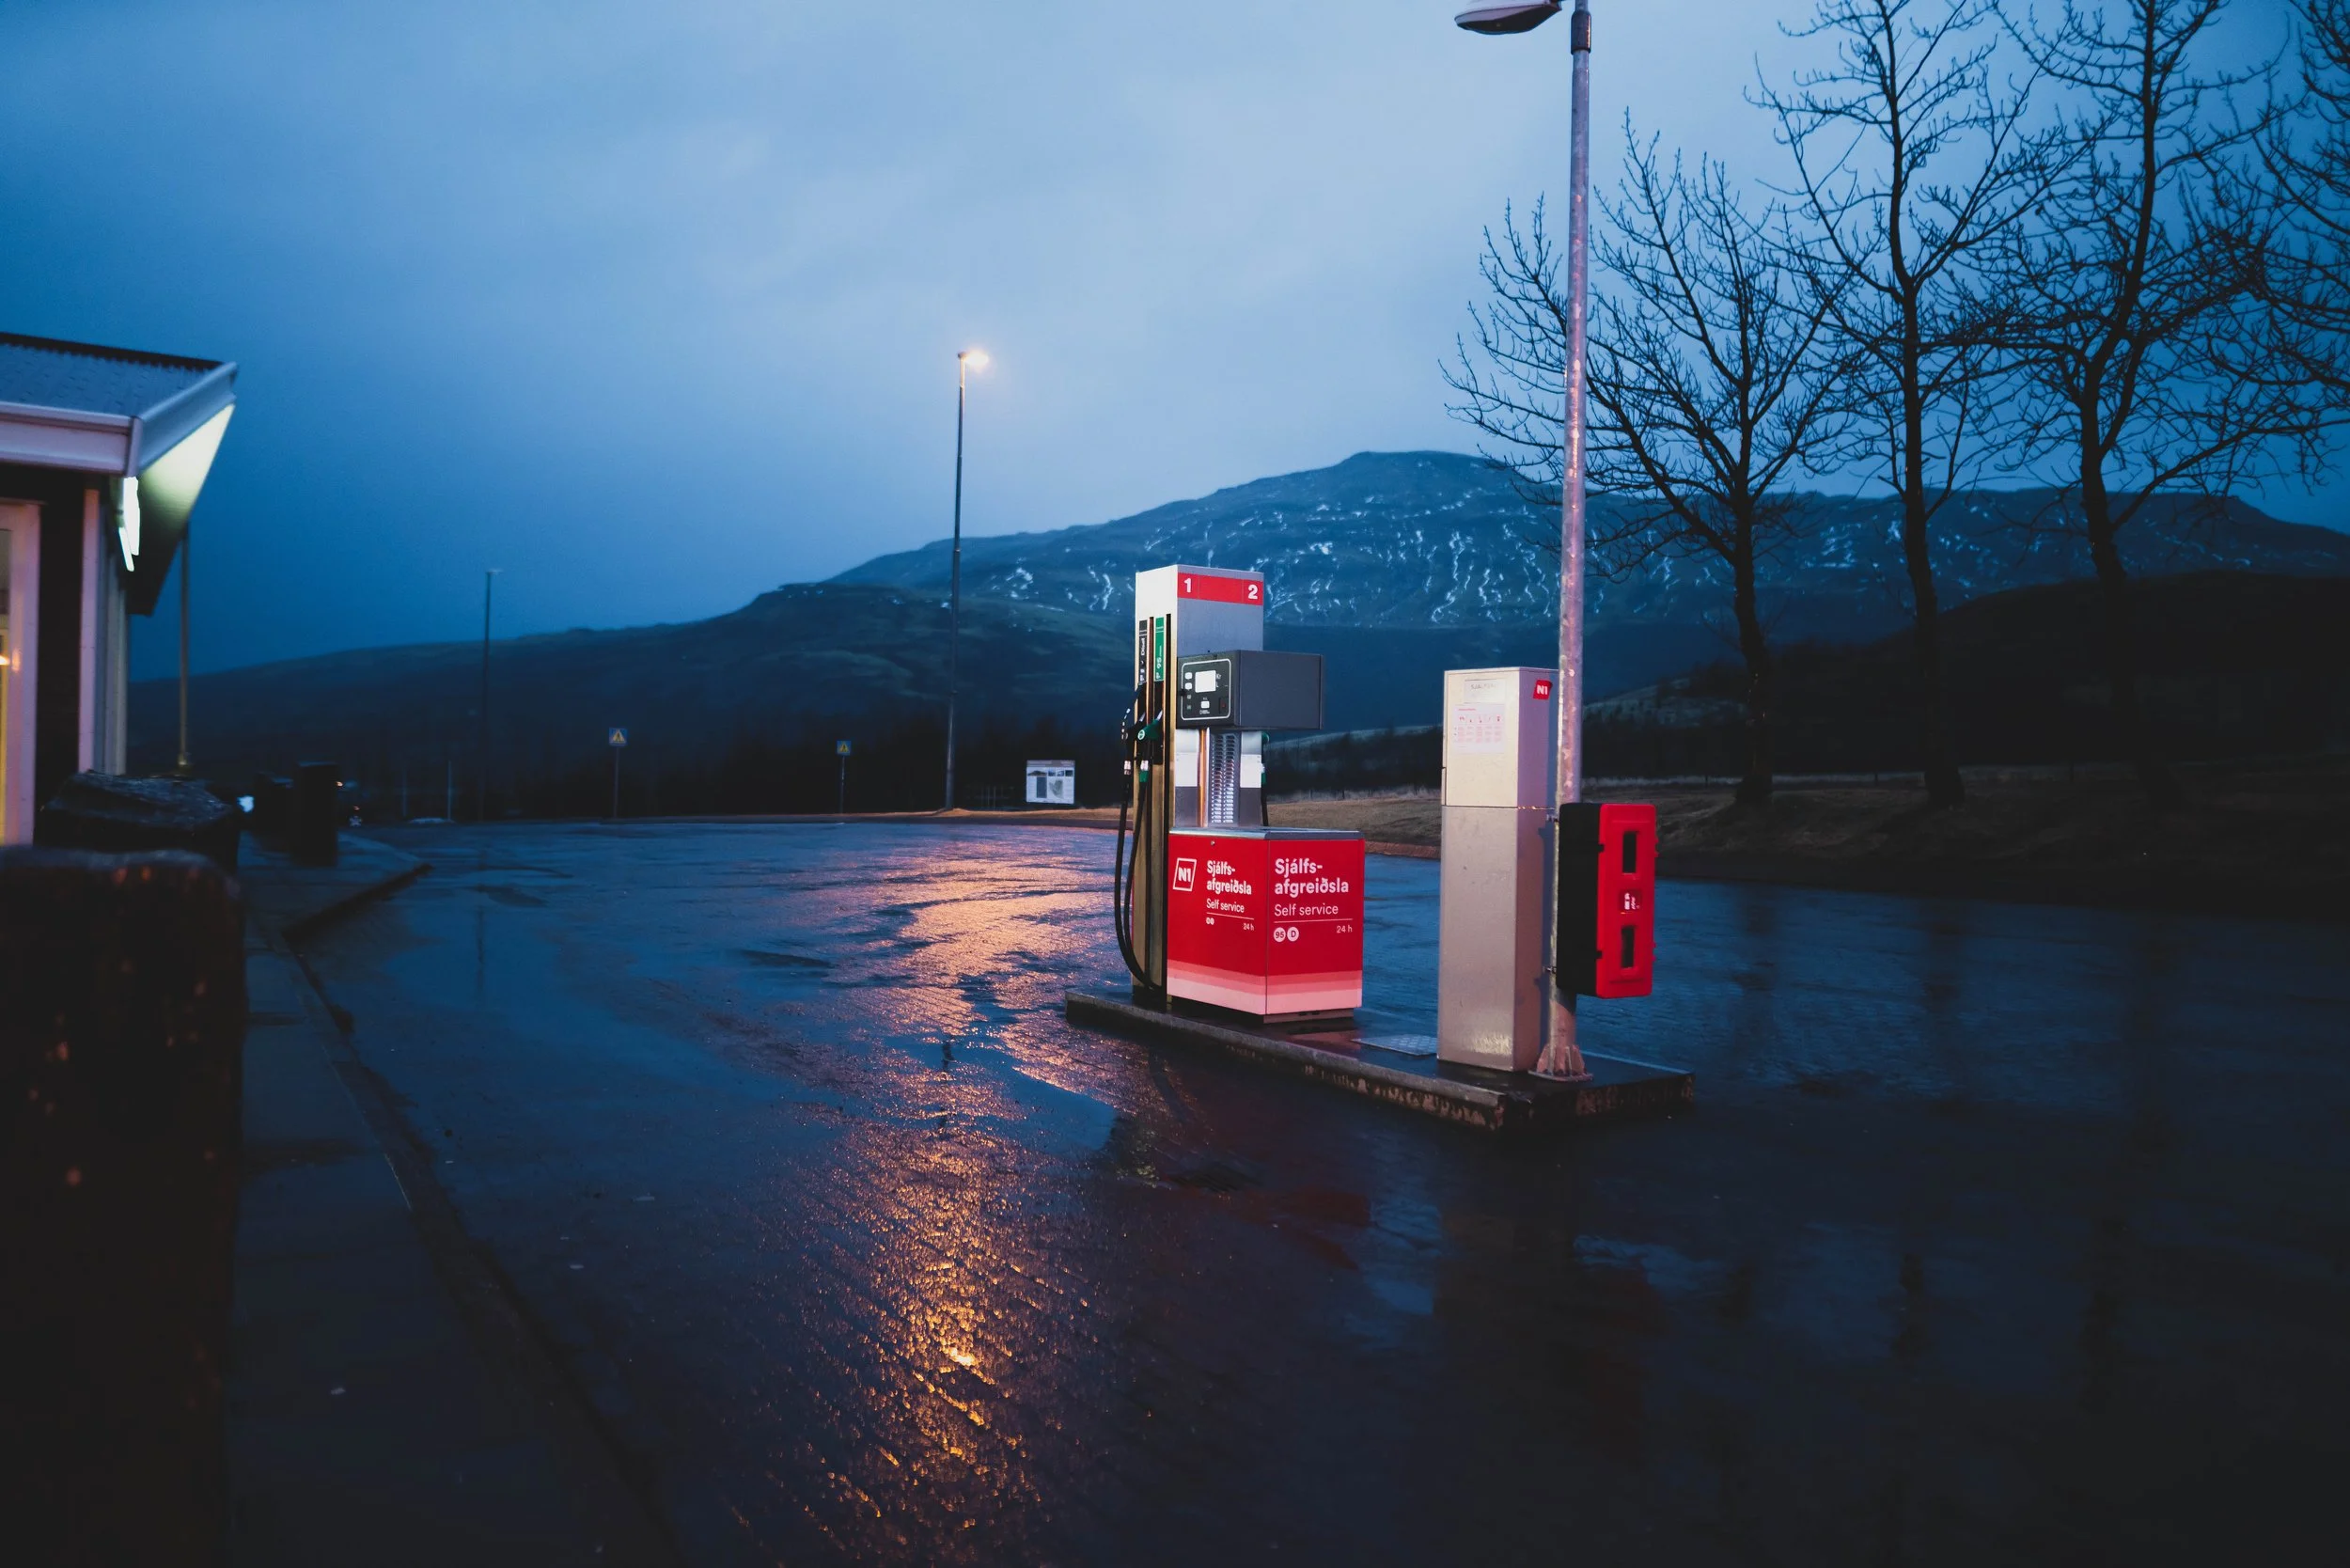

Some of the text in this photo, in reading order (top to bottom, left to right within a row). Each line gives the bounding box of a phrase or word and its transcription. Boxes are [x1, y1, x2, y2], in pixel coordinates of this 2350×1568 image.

[1183, 577, 1192, 593] 1
[1247, 584, 1259, 600] 2
[1536, 684, 1548, 696] N1
[1178, 867, 1192, 883] N1
[1206, 860, 1236, 877] Sjálfs-
[1275, 857, 1323, 878] Sjálfs-
[1206, 877, 1252, 895] afgreiðsla
[1274, 877, 1349, 898] afgreiðsla
[1206, 898, 1245, 914] Self service
[1274, 902, 1339, 917] Self service
[1243, 922, 1250, 931] 24
[1275, 930, 1297, 939] 95 D
[1336, 924, 1353, 933] 24 h
